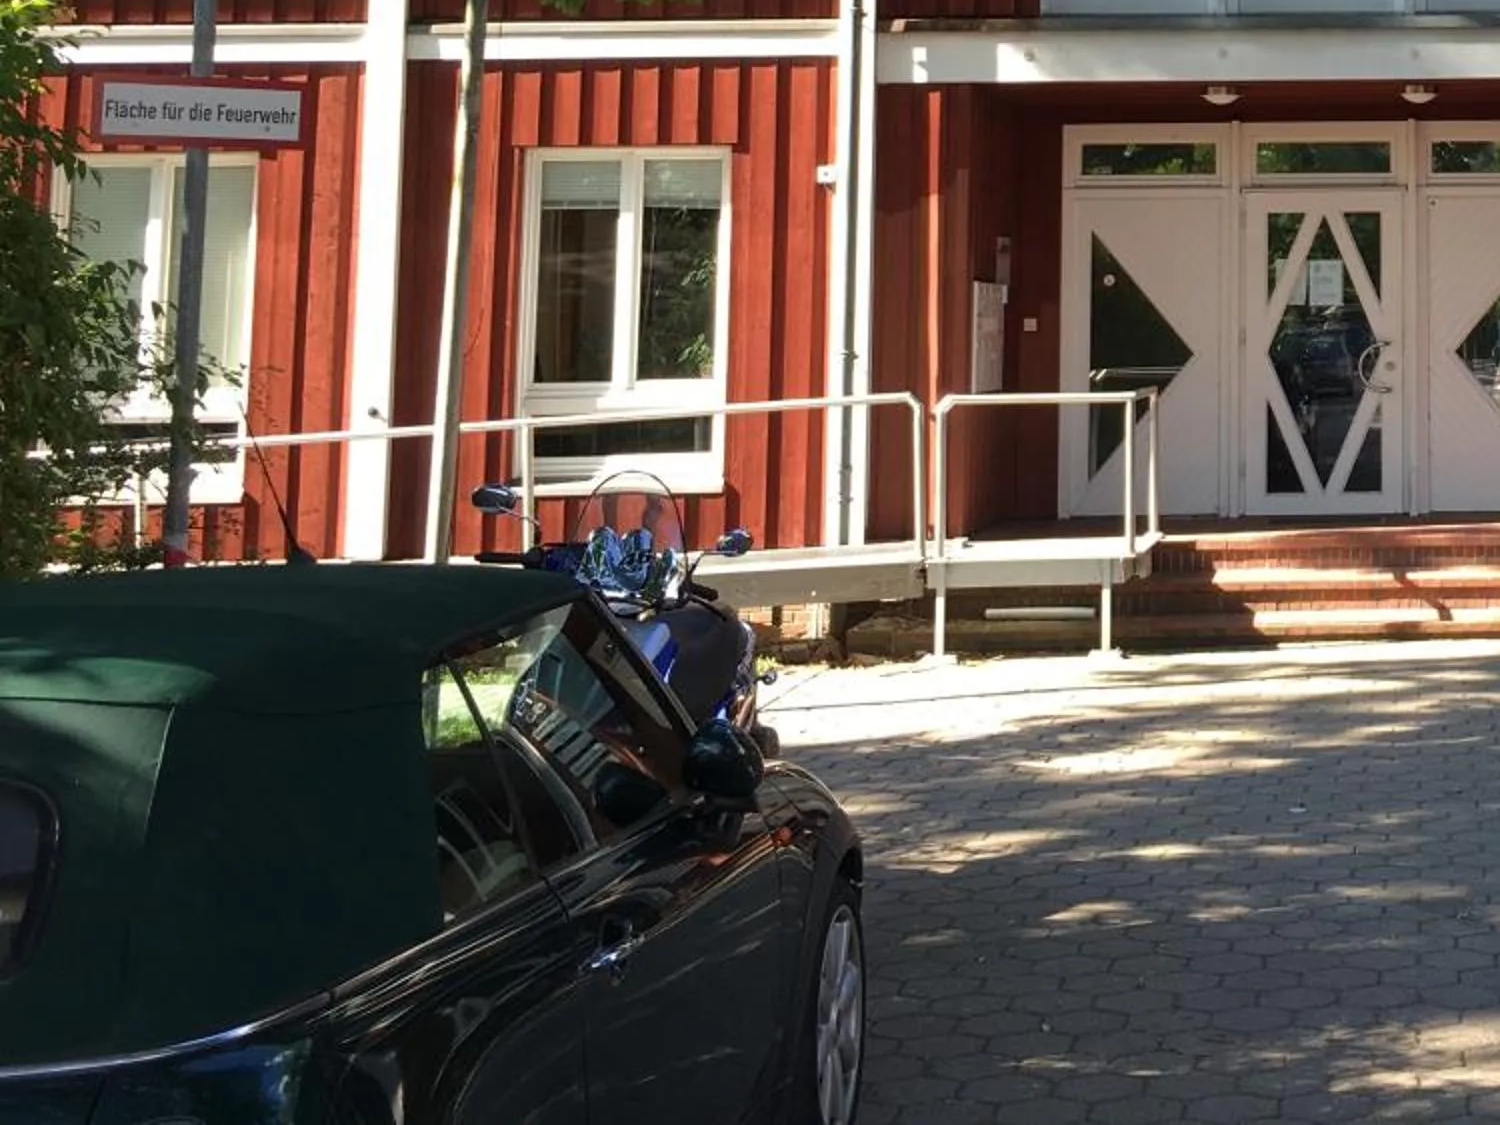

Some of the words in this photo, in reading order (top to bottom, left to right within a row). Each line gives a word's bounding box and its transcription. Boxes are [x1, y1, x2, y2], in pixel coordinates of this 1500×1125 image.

[105, 99, 157, 119] Fläche
[162, 101, 184, 120] für
[189, 102, 212, 122] die
[217, 104, 297, 124] Feuerwehr
